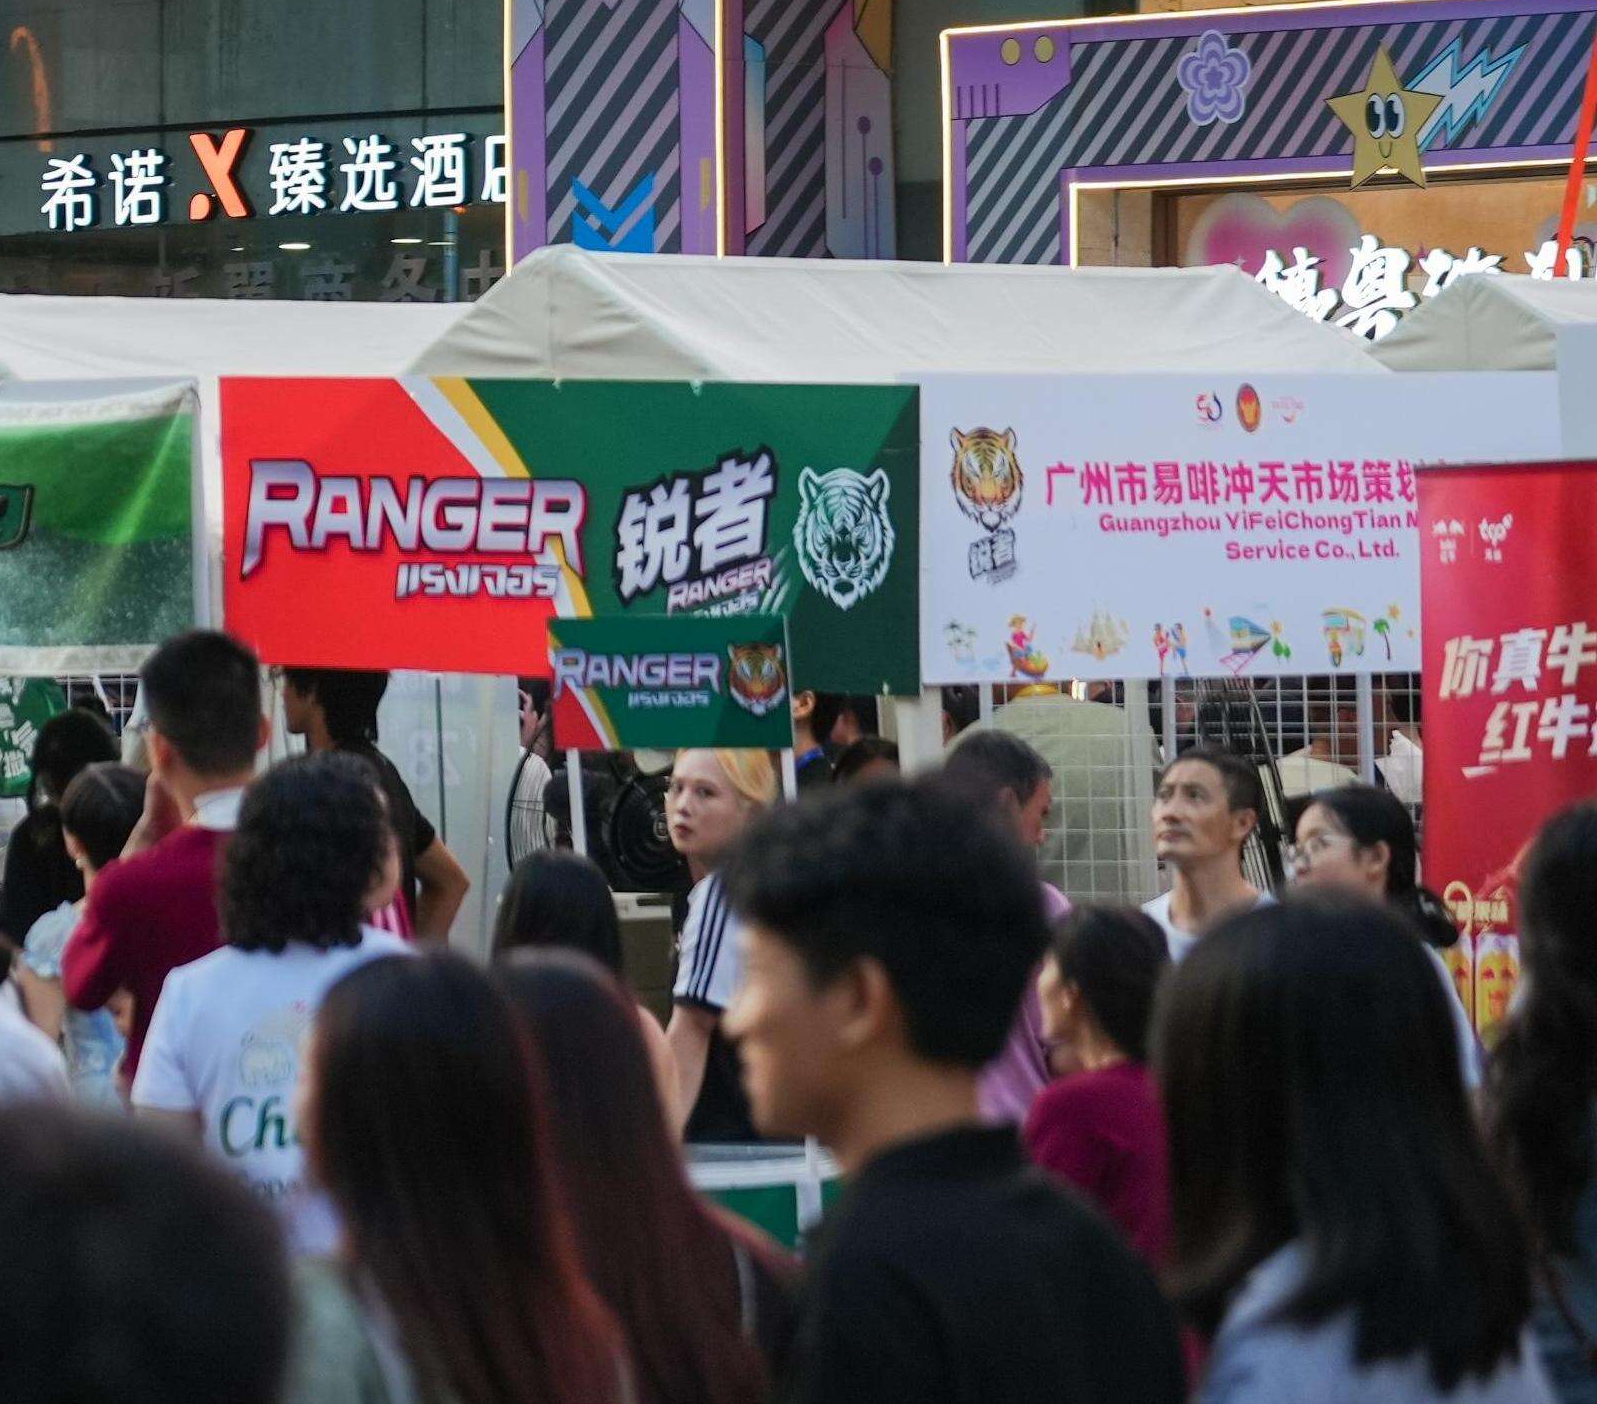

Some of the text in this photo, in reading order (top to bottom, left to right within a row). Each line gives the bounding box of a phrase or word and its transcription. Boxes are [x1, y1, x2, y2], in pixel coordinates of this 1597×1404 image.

[240, 457, 588, 583] RANGER
[617, 450, 777, 599] 锐者
[1099, 512, 1222, 537] Guangzhou
[1226, 508, 1401, 535] YiFeiChongTian
[1225, 538, 1400, 561] Service Co., Ltd.
[668, 558, 773, 615] RANGER
[553, 647, 722, 699] RANGER
[1438, 621, 1597, 700] 你真牛
[1478, 693, 1597, 762] 红牛
[219, 1095, 302, 1158] Ch
